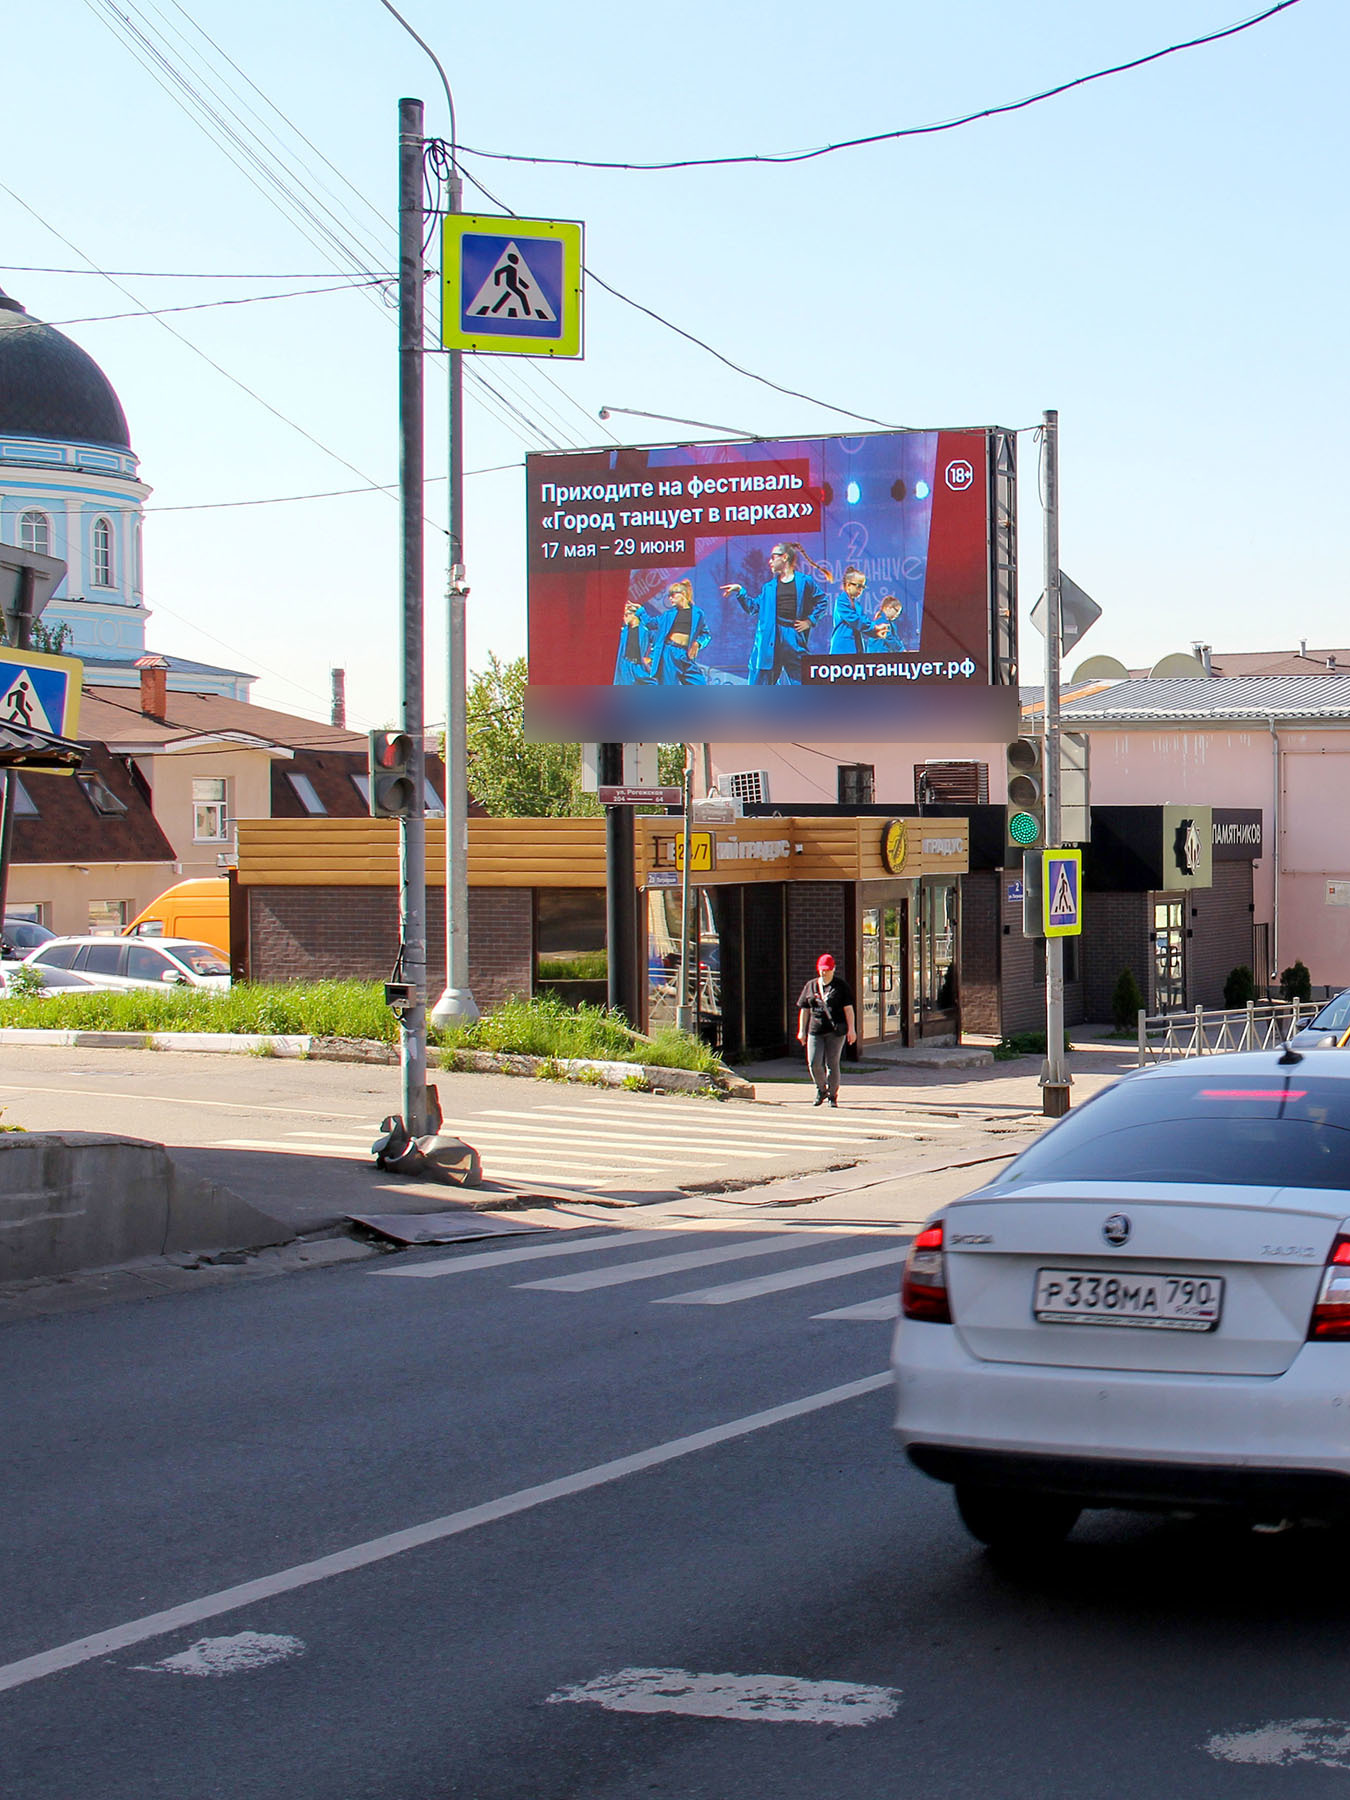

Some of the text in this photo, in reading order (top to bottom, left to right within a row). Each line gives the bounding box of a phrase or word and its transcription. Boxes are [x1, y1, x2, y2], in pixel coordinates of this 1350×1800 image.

[950, 468, 971, 483] 18+
[541, 474, 803, 504] Приходите на фестиваль
[541, 501, 814, 533] «Город танцует в парках»
[541, 542, 560, 559] 17
[564, 542, 596, 558] мая
[614, 538, 636, 555] 29
[640, 538, 685, 554] июня
[810, 657, 976, 682] городтанцует.рф
[1212, 823, 1261, 844] ПАМЯТНИКОВ
[678, 843, 708, 860] 2/7
[922, 837, 964, 857] ГРАДУС
[1166, 1280, 1213, 1305] 790
